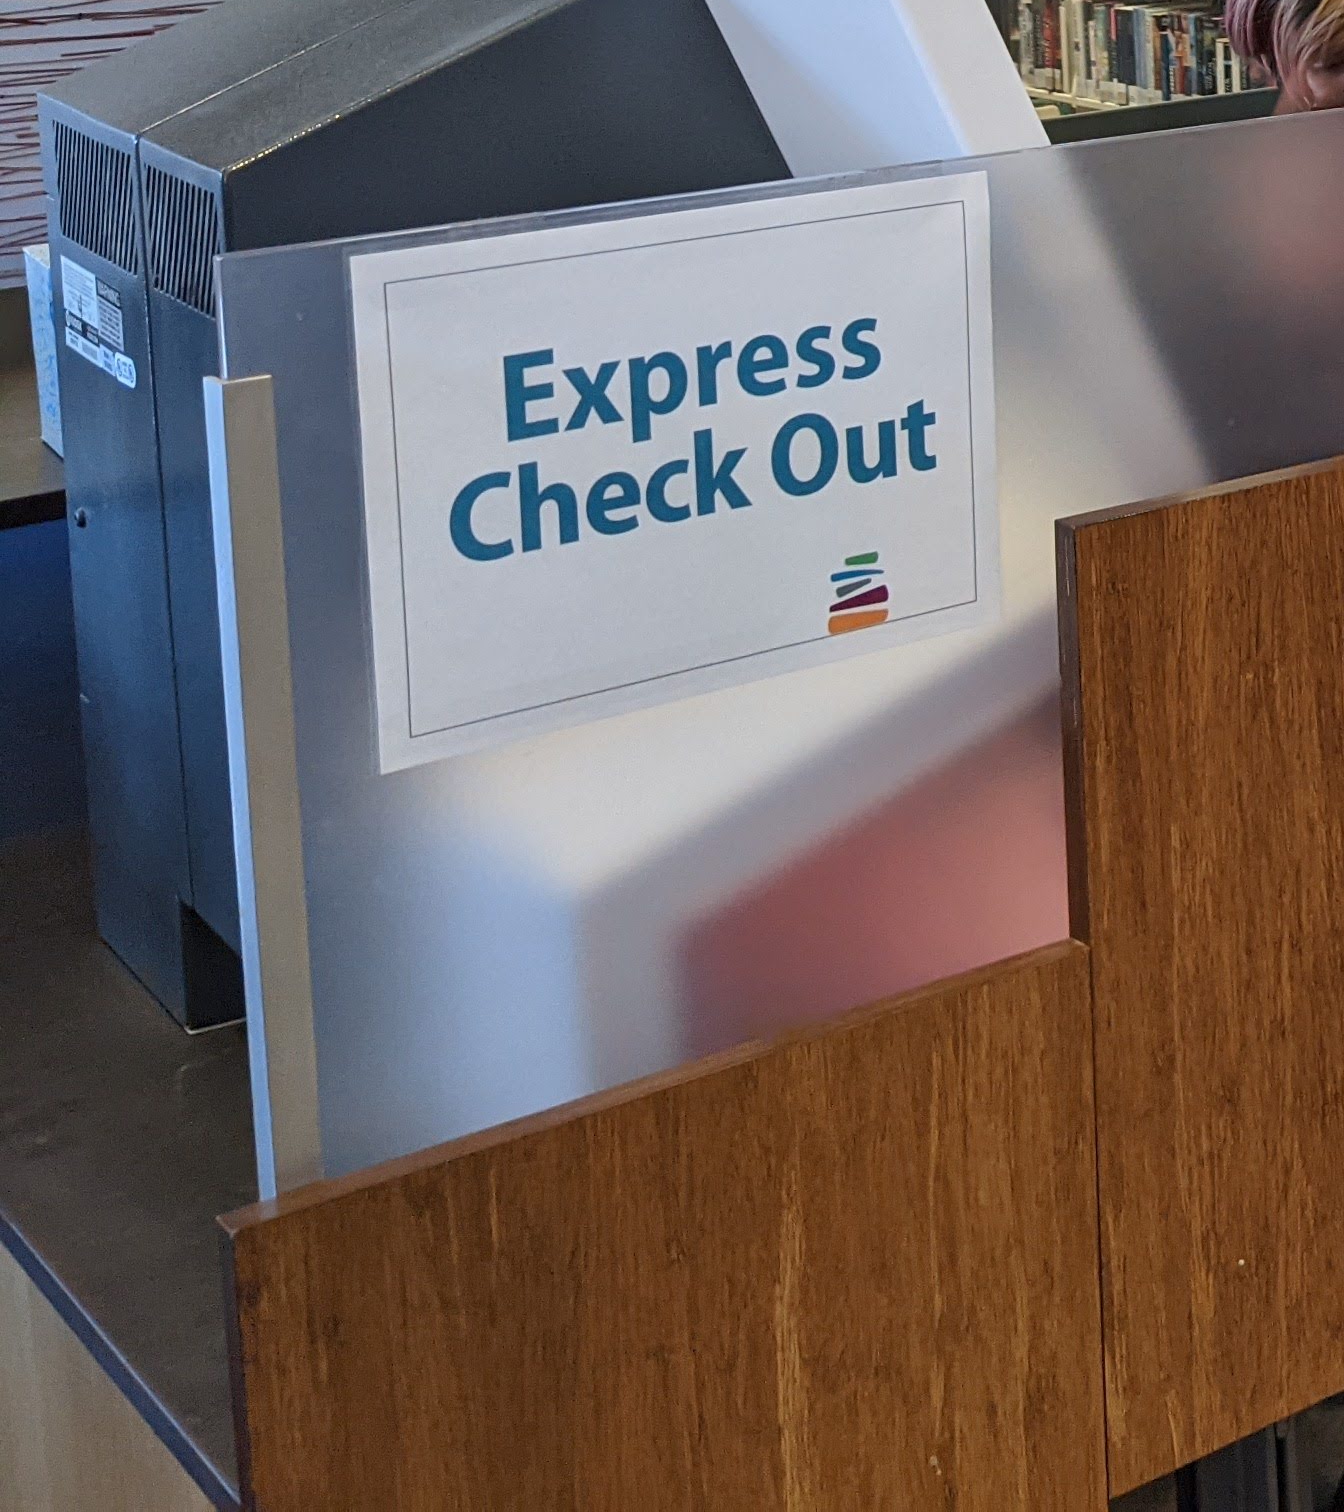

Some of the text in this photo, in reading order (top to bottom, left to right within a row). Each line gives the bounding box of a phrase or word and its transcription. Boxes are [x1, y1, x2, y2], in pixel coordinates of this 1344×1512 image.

[503, 318, 881, 442] Express
[449, 399, 937, 562] Check Out
